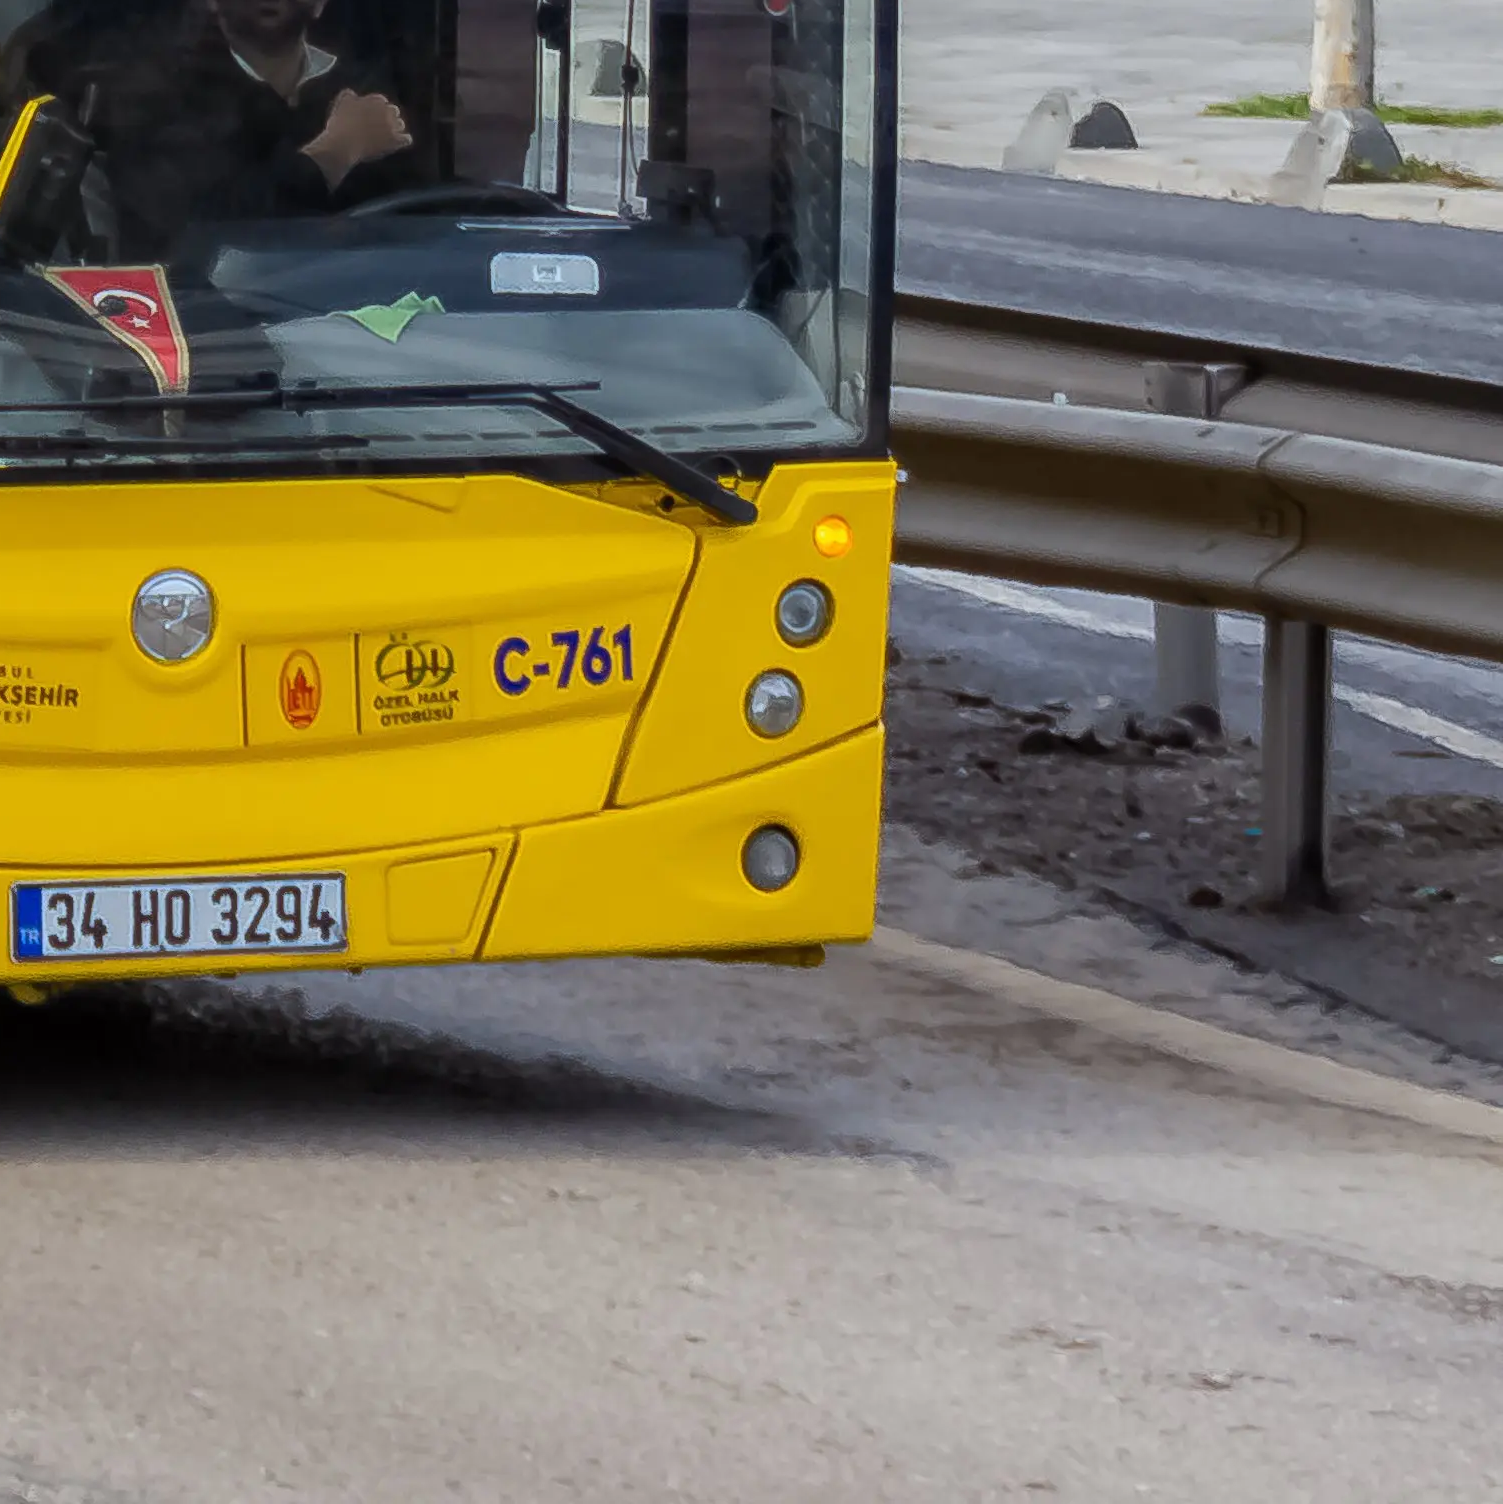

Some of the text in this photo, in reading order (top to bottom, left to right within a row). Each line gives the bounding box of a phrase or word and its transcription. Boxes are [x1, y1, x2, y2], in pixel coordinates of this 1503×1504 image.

[494, 624, 633, 696] C-761
[19, 927, 40, 946] TR
[48, 891, 108, 950] 34
[212, 883, 336, 946] 3294
